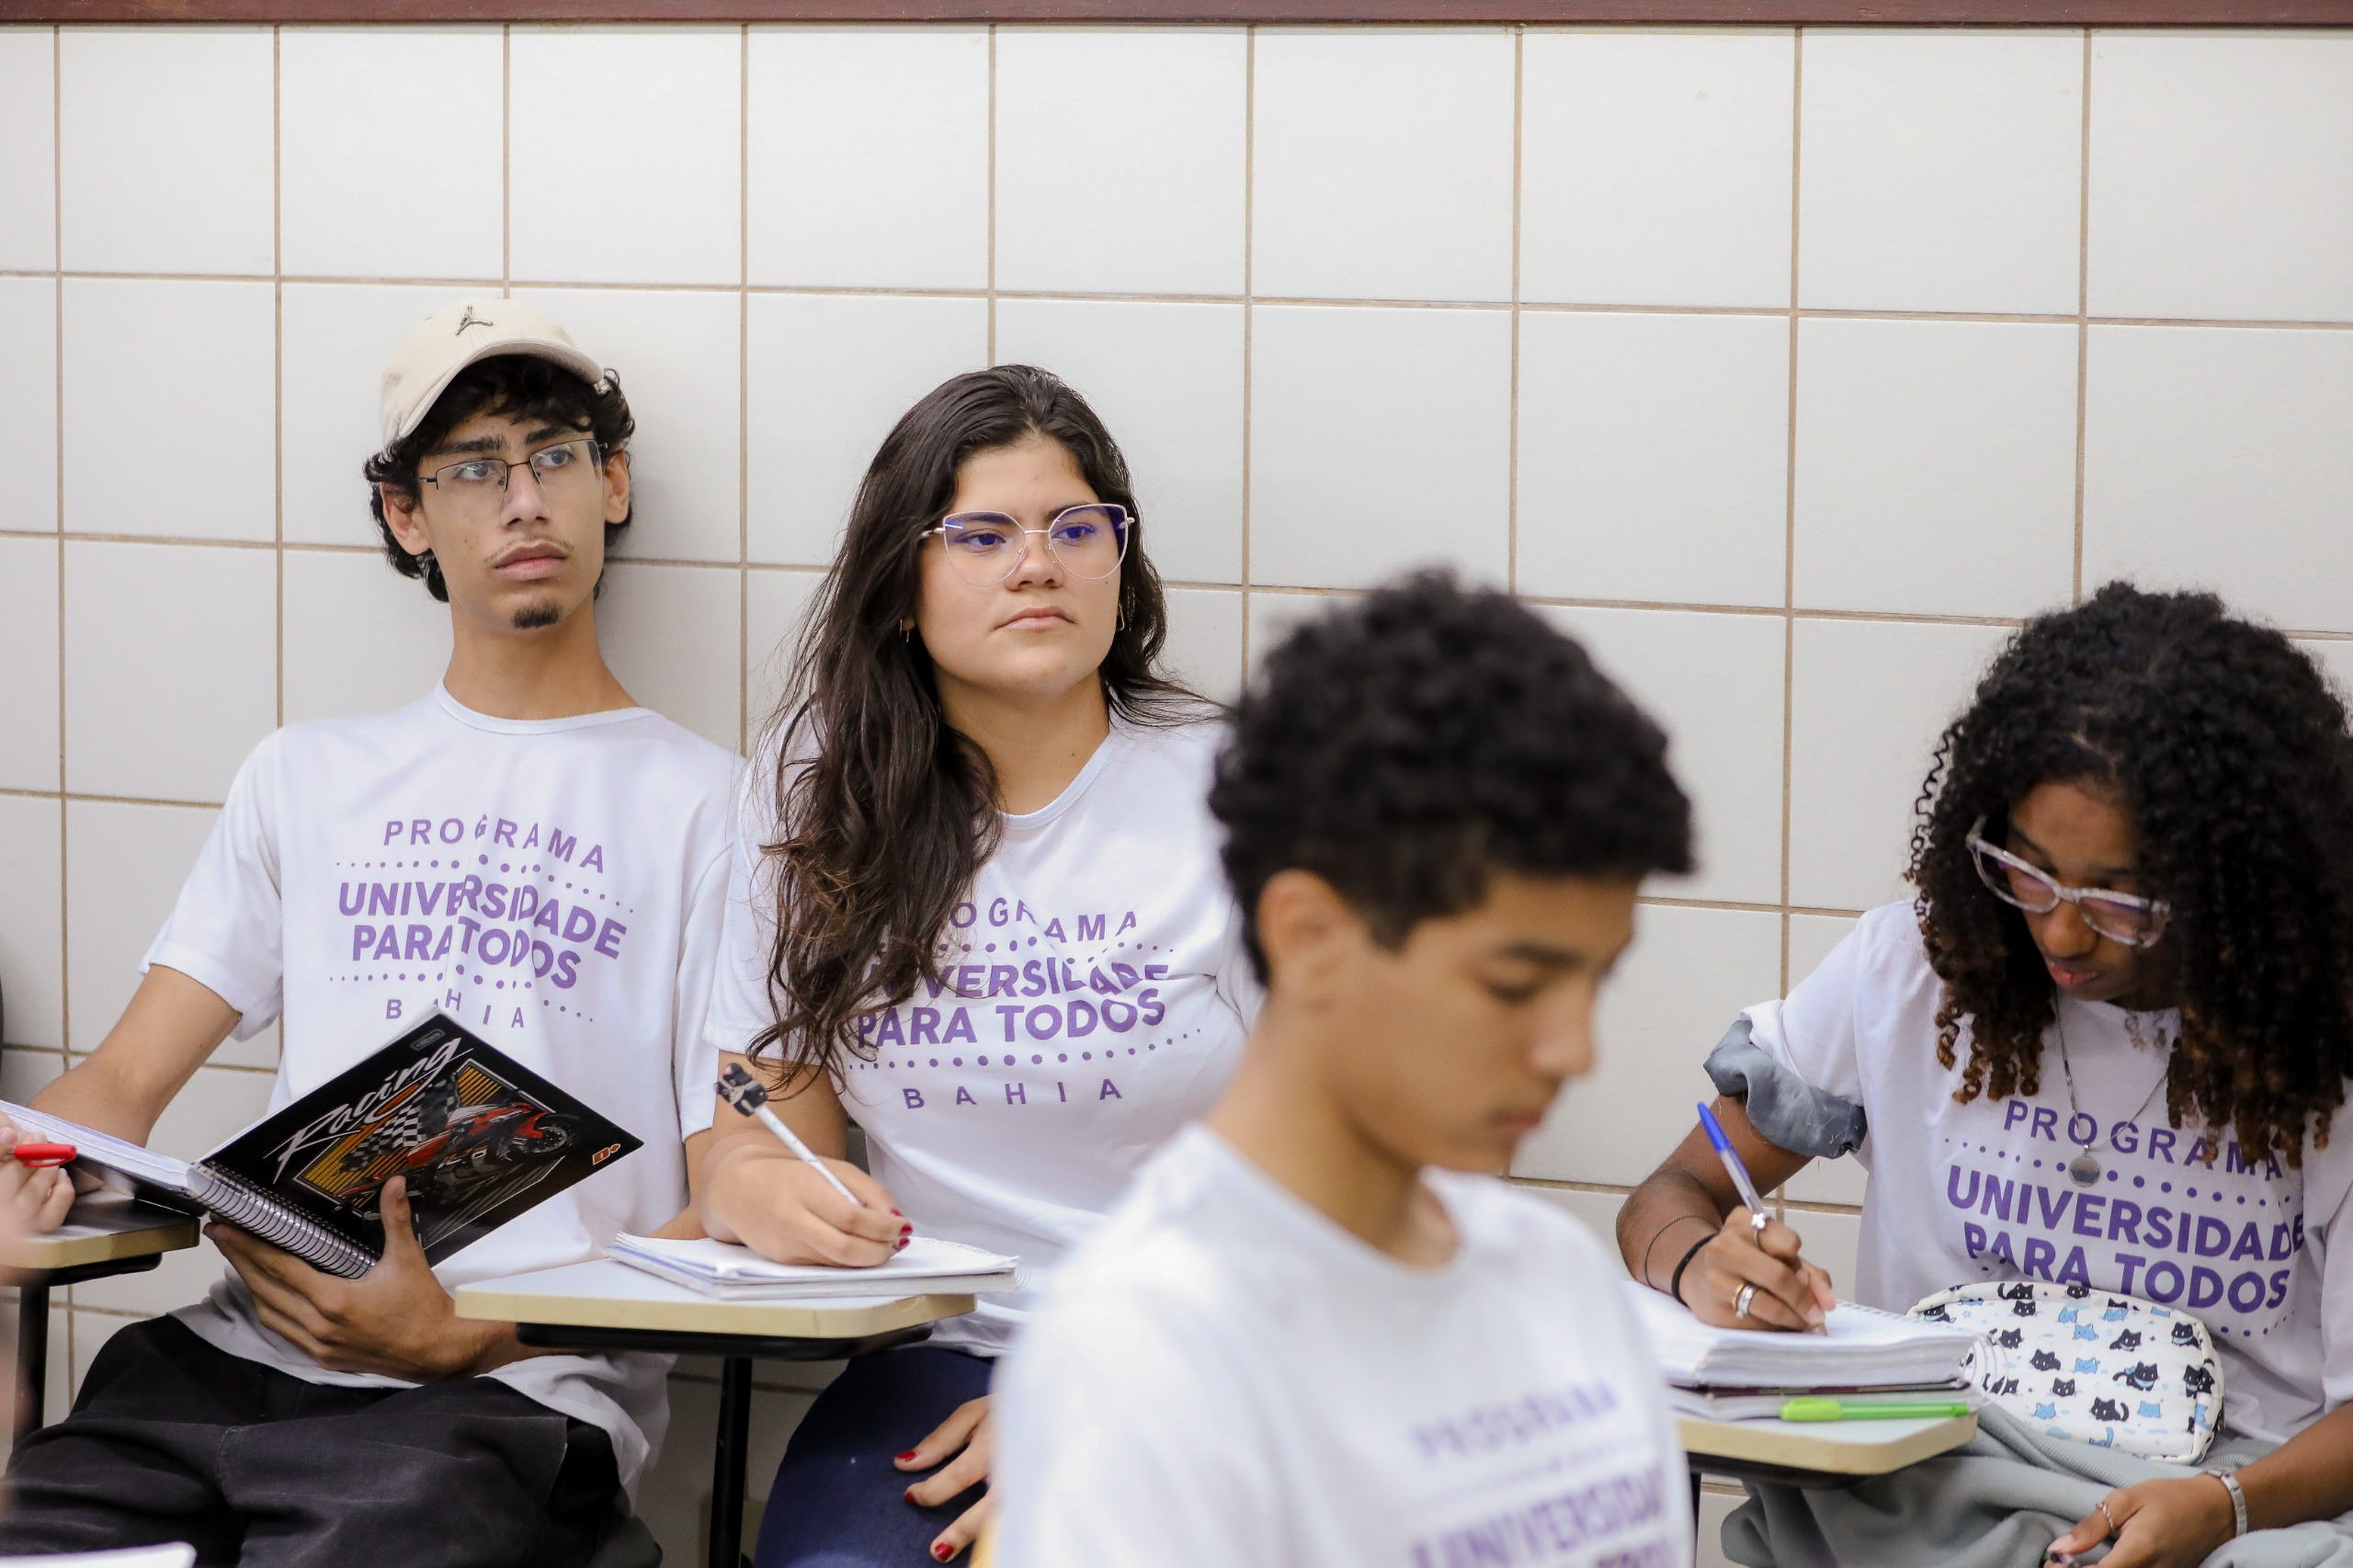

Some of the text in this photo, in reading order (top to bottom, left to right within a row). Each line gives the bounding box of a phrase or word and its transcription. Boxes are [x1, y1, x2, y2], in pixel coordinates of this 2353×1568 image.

[383, 813, 604, 874] PROGRAMA
[338, 874, 628, 960] UNIVERSIDADE
[352, 915, 582, 990] PARA TODOS
[858, 988, 1165, 1049] PARA TODOS
[263, 1037, 473, 1185] Racing
[903, 1078, 1122, 1109] BAHIA
[1964, 1221, 2290, 1314] PARA TODOS
